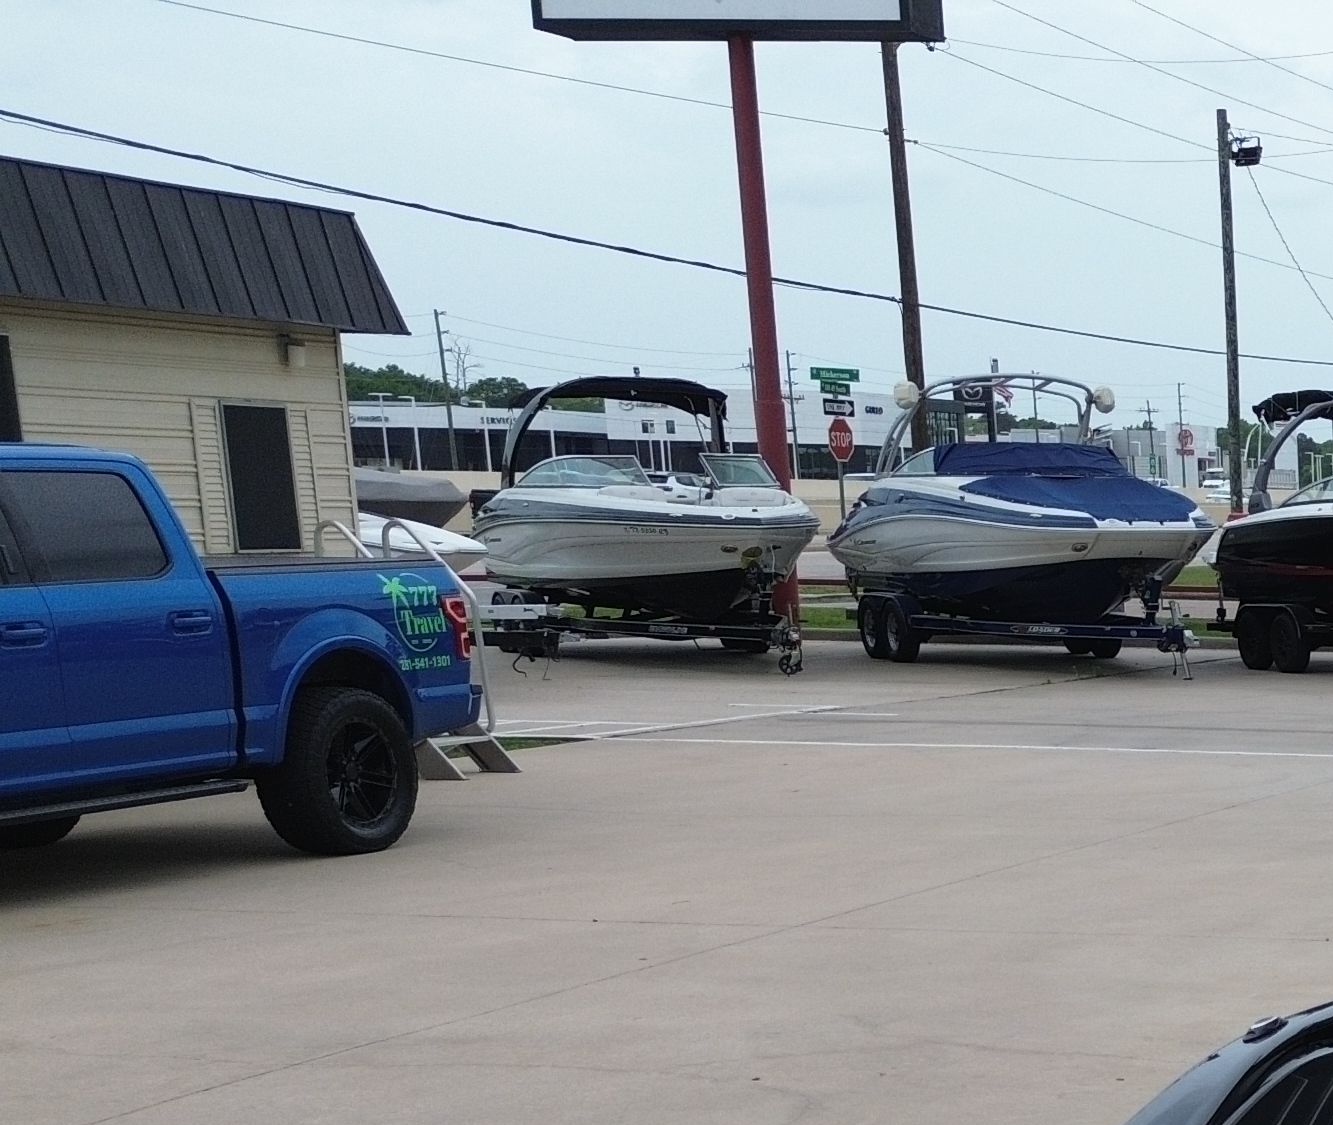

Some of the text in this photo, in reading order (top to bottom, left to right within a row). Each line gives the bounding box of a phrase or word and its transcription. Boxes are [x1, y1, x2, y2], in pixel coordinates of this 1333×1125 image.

[830, 431, 852, 447] STOP
[408, 585, 438, 607] 777
[400, 607, 448, 636] Travel
